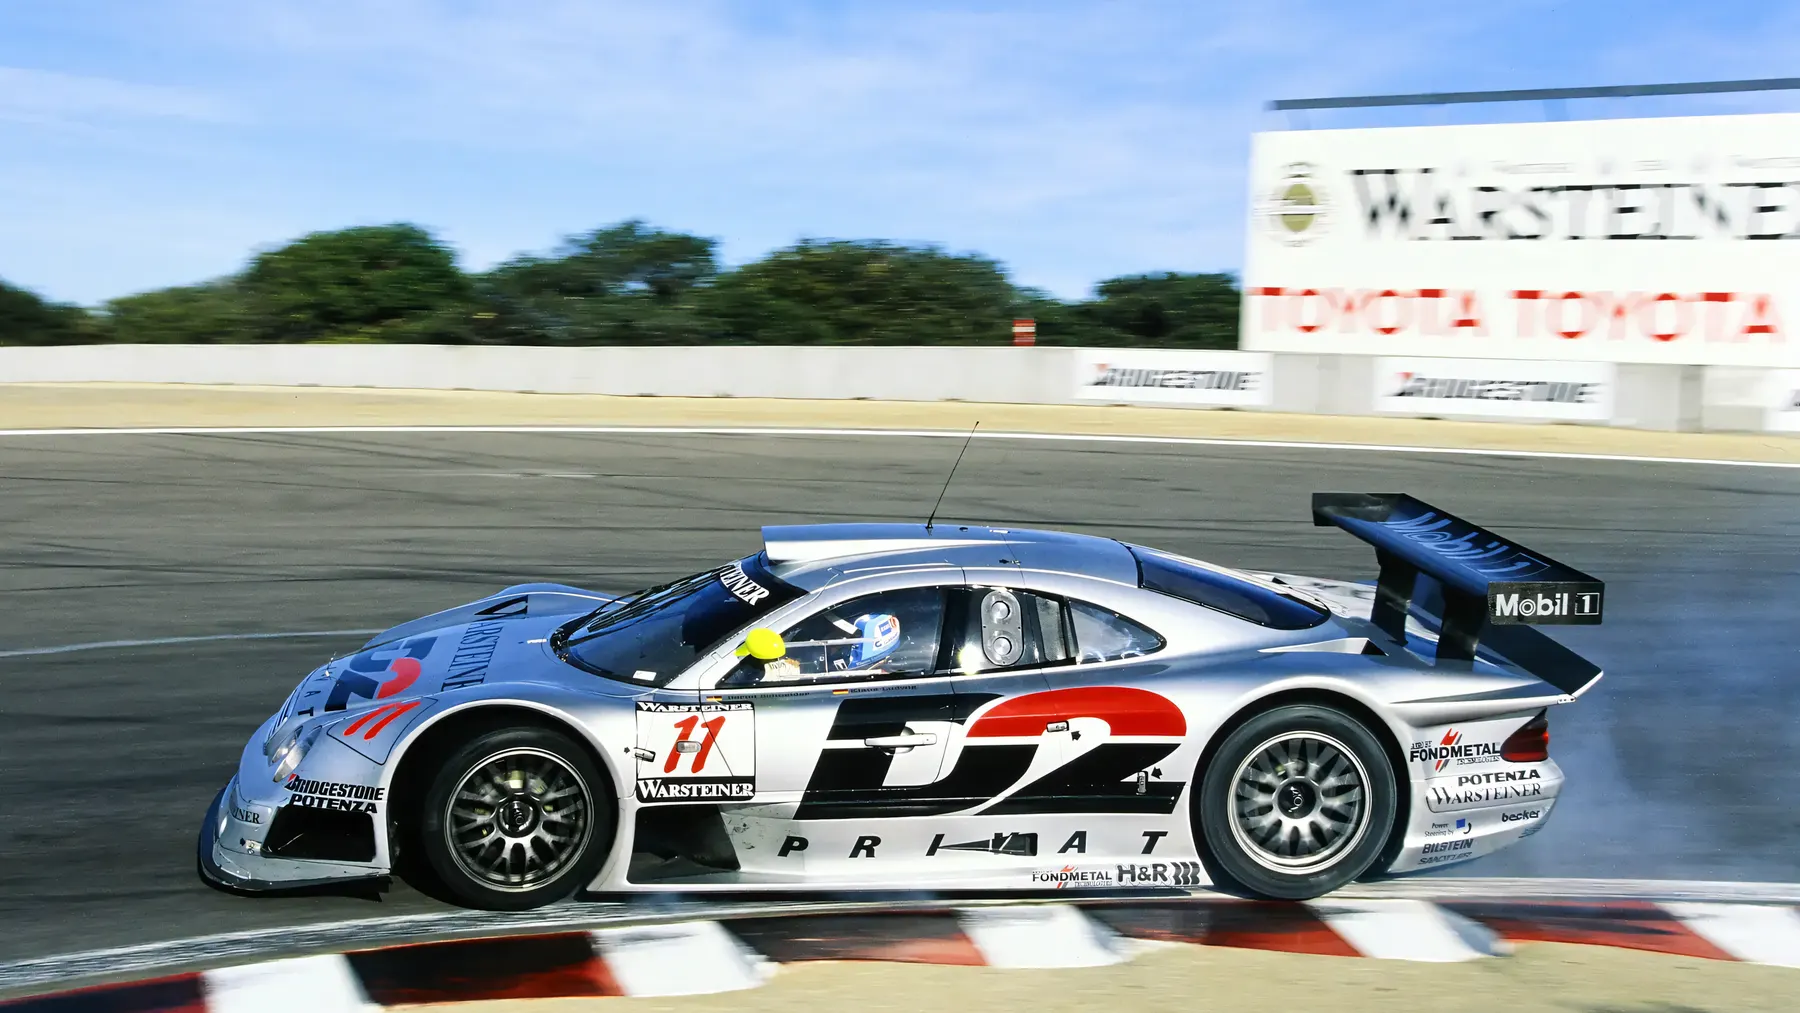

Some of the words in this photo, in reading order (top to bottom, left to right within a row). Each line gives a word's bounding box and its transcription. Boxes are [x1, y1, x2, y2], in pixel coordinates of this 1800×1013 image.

[1247, 287, 1489, 336] TOYOTA
[1510, 290, 1786, 343] TOYOTA
[1377, 511, 1509, 560] Mobil
[1496, 593, 1569, 616] Mobil
[637, 702, 753, 712] WARSTEINER
[664, 715, 726, 774] 11
[792, 686, 1187, 820] D2
[1410, 742, 1501, 762] FONDMETAL
[284, 773, 385, 800] BRIDGESTONE
[1458, 769, 1541, 786] POTENZA
[637, 779, 755, 799] WARSTEINER
[1431, 782, 1541, 805] WARSTEINER
[289, 794, 378, 813] POTENZA
[1501, 810, 1541, 822] becker
[1422, 839, 1474, 854] BILSTEIN
[1032, 871, 1112, 882] FONDMETAL
[1117, 863, 1168, 883] H&R
